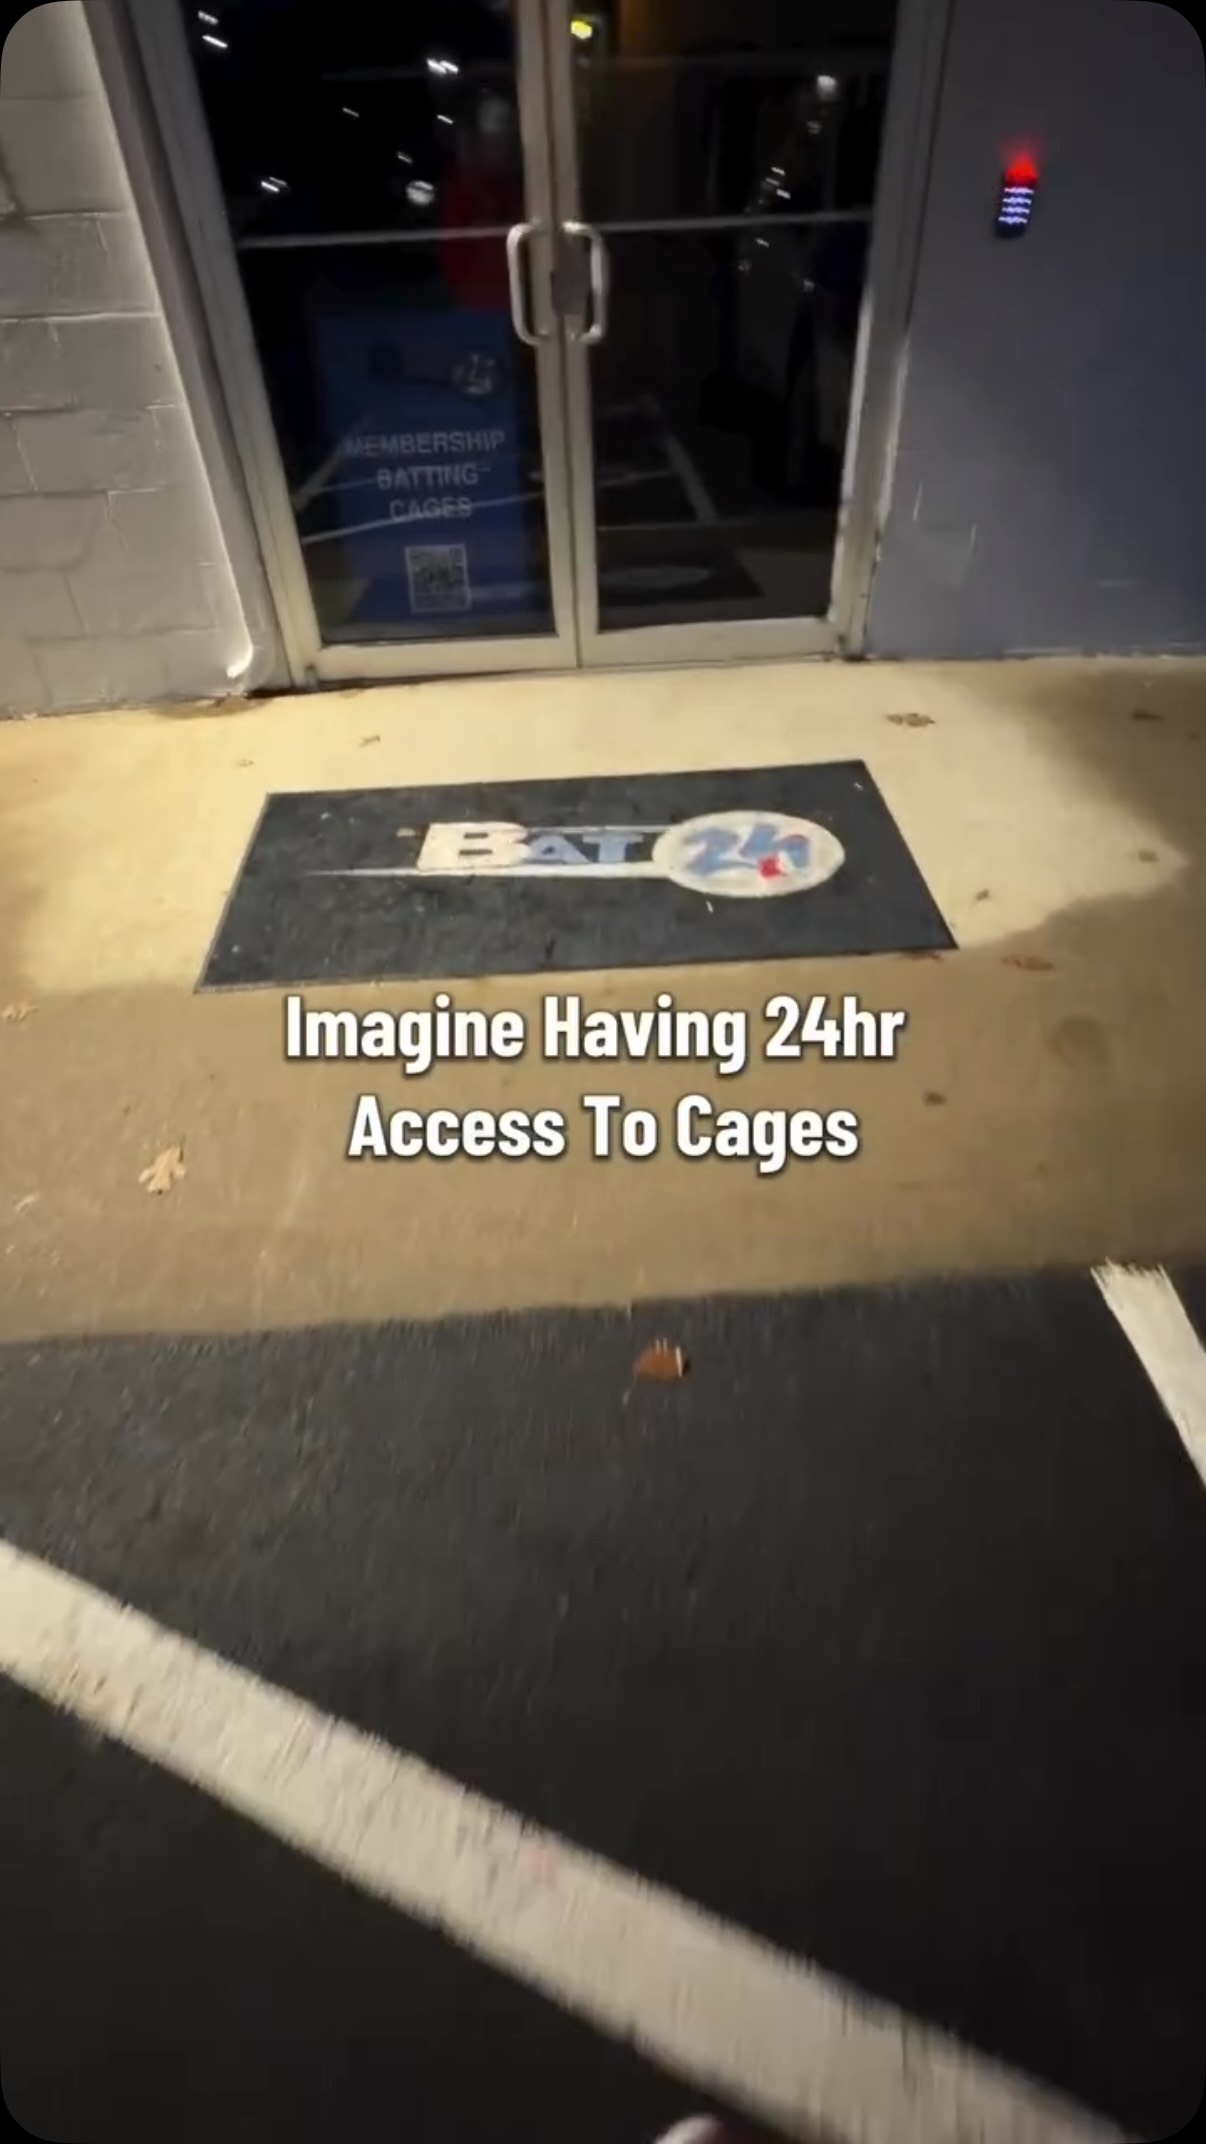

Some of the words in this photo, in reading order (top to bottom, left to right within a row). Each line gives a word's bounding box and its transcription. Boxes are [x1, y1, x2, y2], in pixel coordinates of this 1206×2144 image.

[343, 430, 505, 456] MEMBERSHIP
[377, 462, 480, 490] BATTING
[389, 497, 473, 520] CAGES
